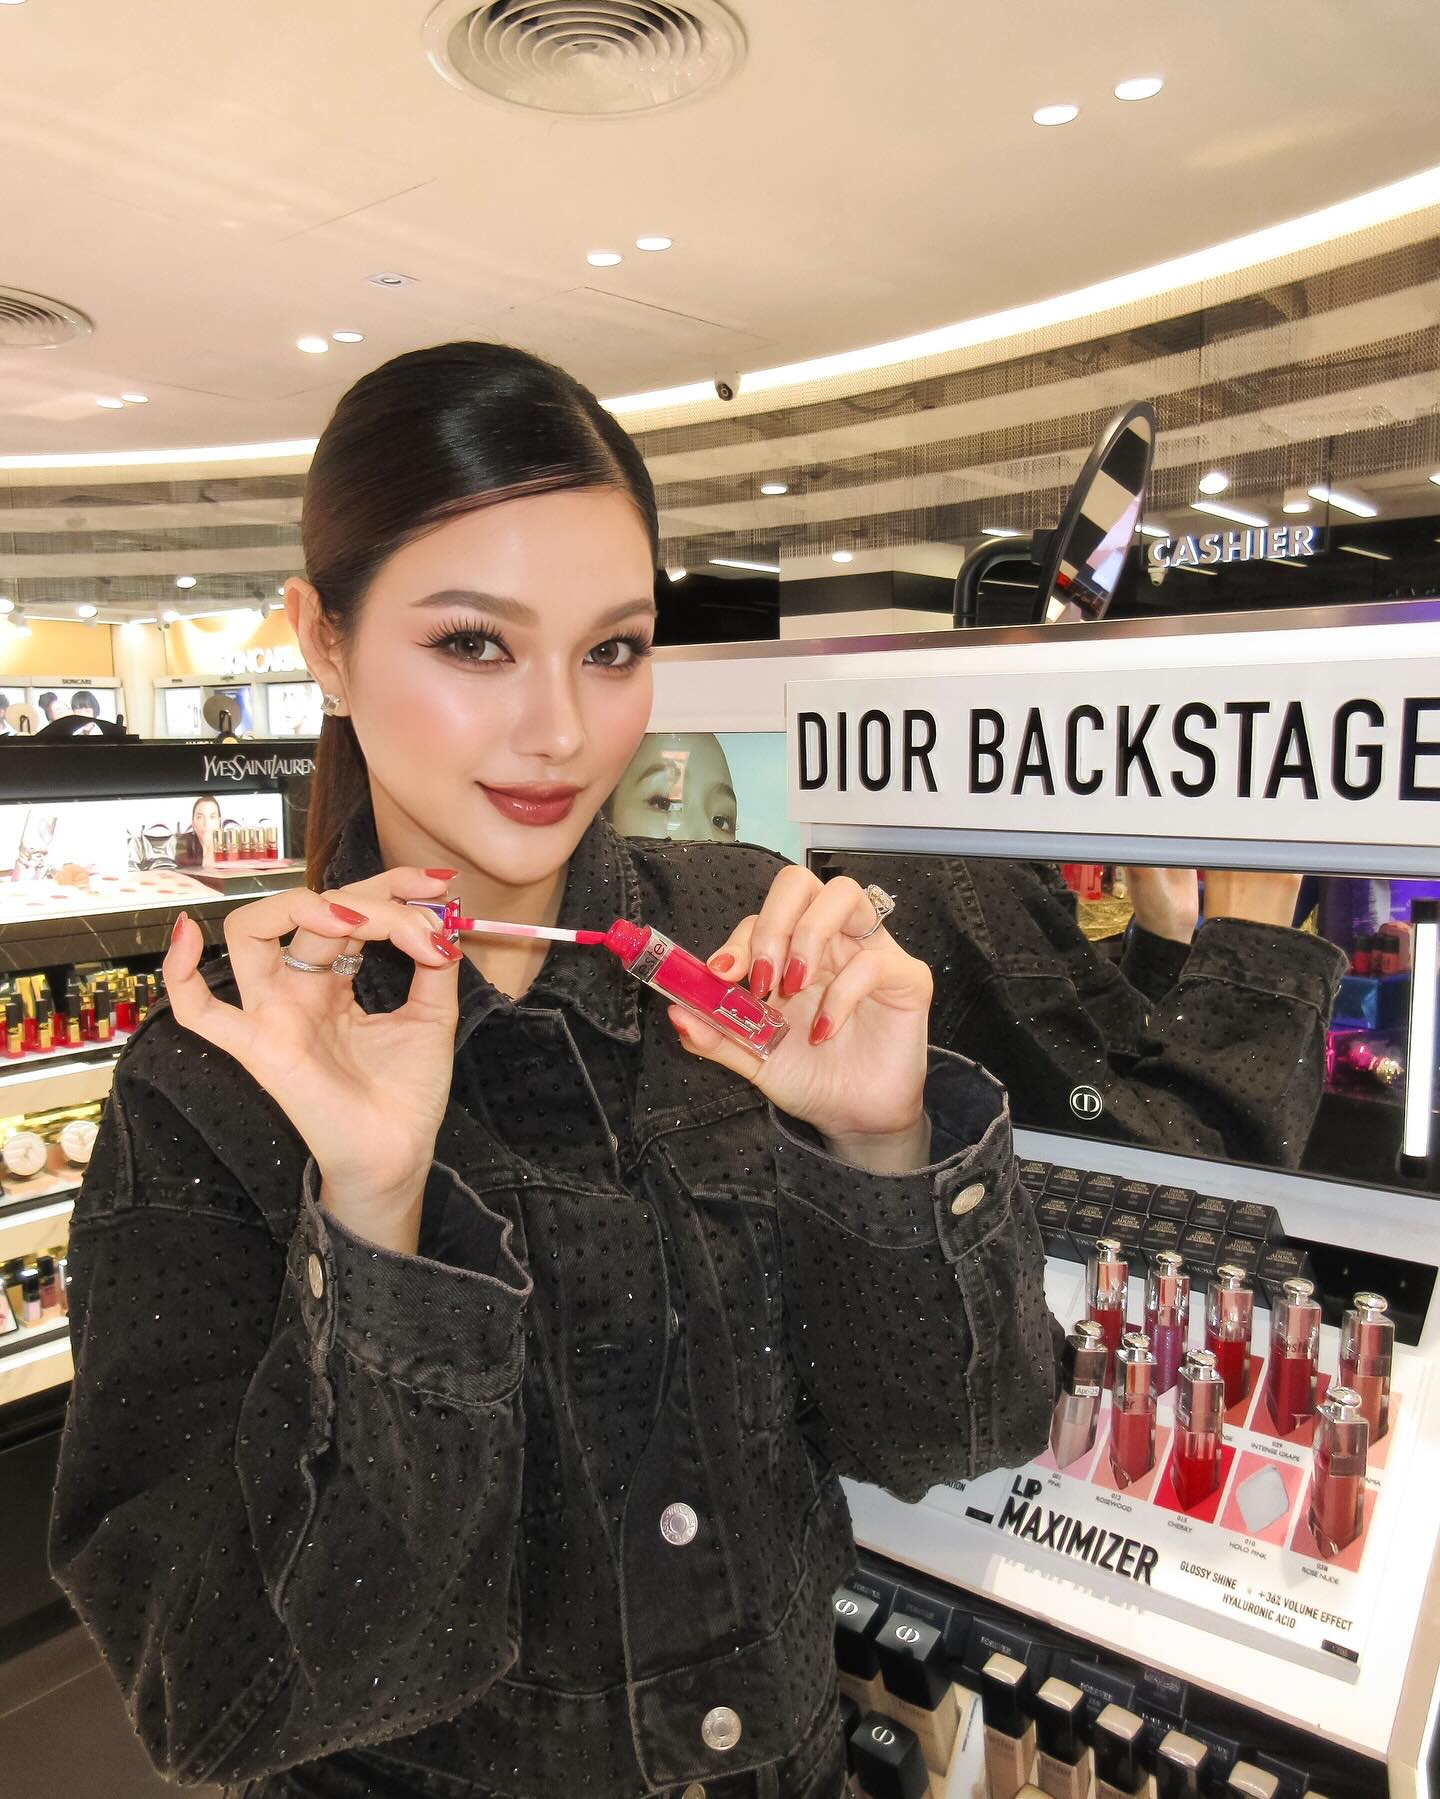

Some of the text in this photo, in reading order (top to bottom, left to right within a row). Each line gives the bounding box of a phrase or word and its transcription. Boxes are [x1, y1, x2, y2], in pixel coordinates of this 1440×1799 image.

[1148, 526, 1314, 568] CASHIER
[798, 696, 1440, 802] DIOR BACKSTAGE
[1251, 1443, 1300, 1463] INTENSE GRAPE
[1011, 1474, 1042, 1500] LIP
[1095, 1496, 1132, 1512] ROSEWOOD
[1167, 1520, 1193, 1534] CHERRY
[998, 1496, 1159, 1586] MAXIMIZER
[1229, 1541, 1267, 1560] HOLO PINK
[1318, 1574, 1340, 1585] NUDE
[1179, 1560, 1211, 1581] GLOSSY
[1212, 1572, 1238, 1590] SHINE
[1283, 1598, 1320, 1621] VOLUME
[1320, 1611, 1353, 1632] EFFECT
[1222, 1593, 1296, 1629] HYALURONIC ACID
